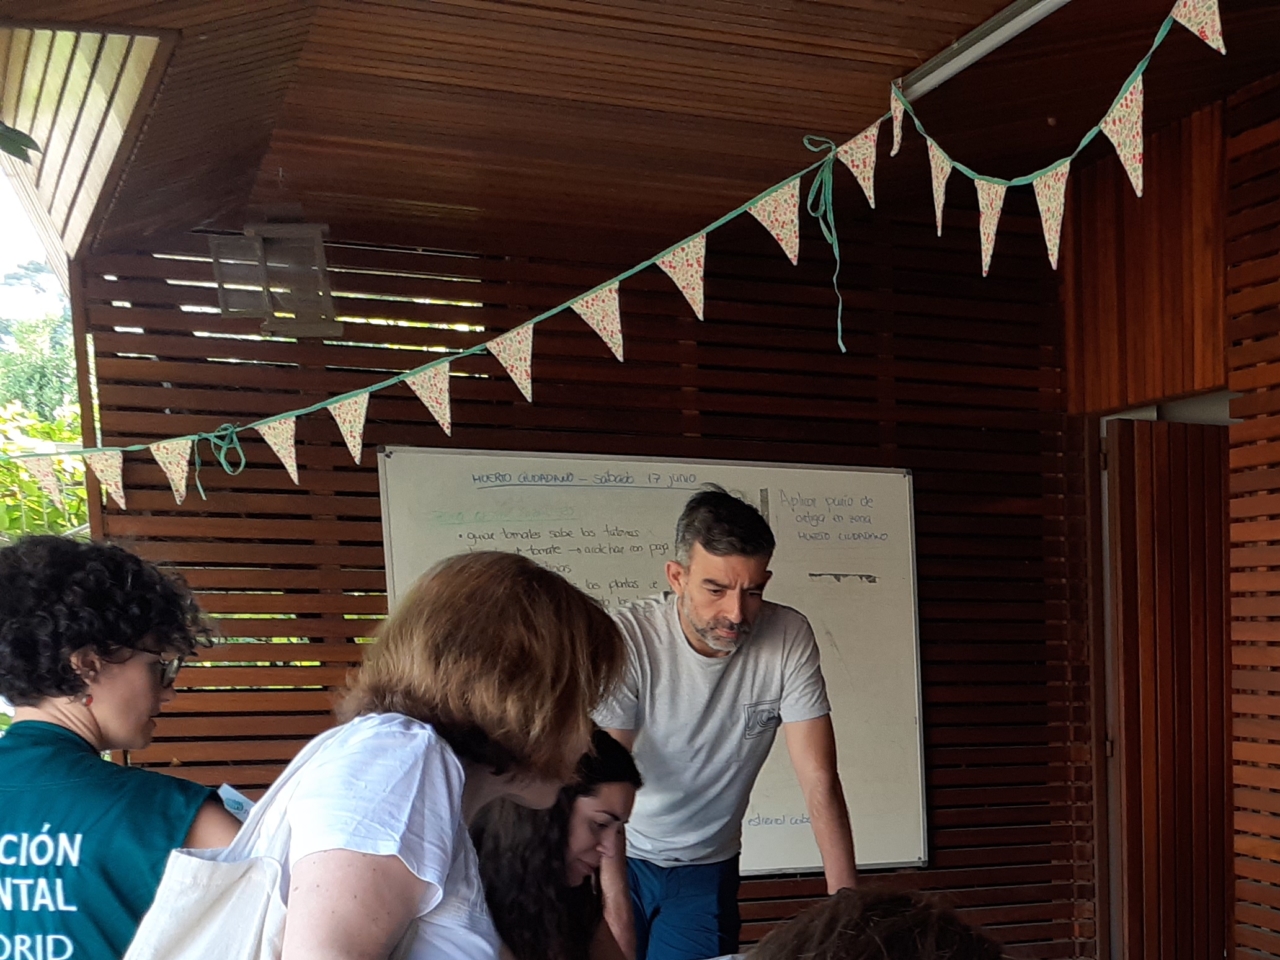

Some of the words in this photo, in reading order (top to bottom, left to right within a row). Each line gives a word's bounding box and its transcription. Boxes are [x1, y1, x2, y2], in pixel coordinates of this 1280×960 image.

[471, 471, 511, 484] HUERTO
[647, 472, 661, 484] 17
[667, 472, 697, 488] junio
